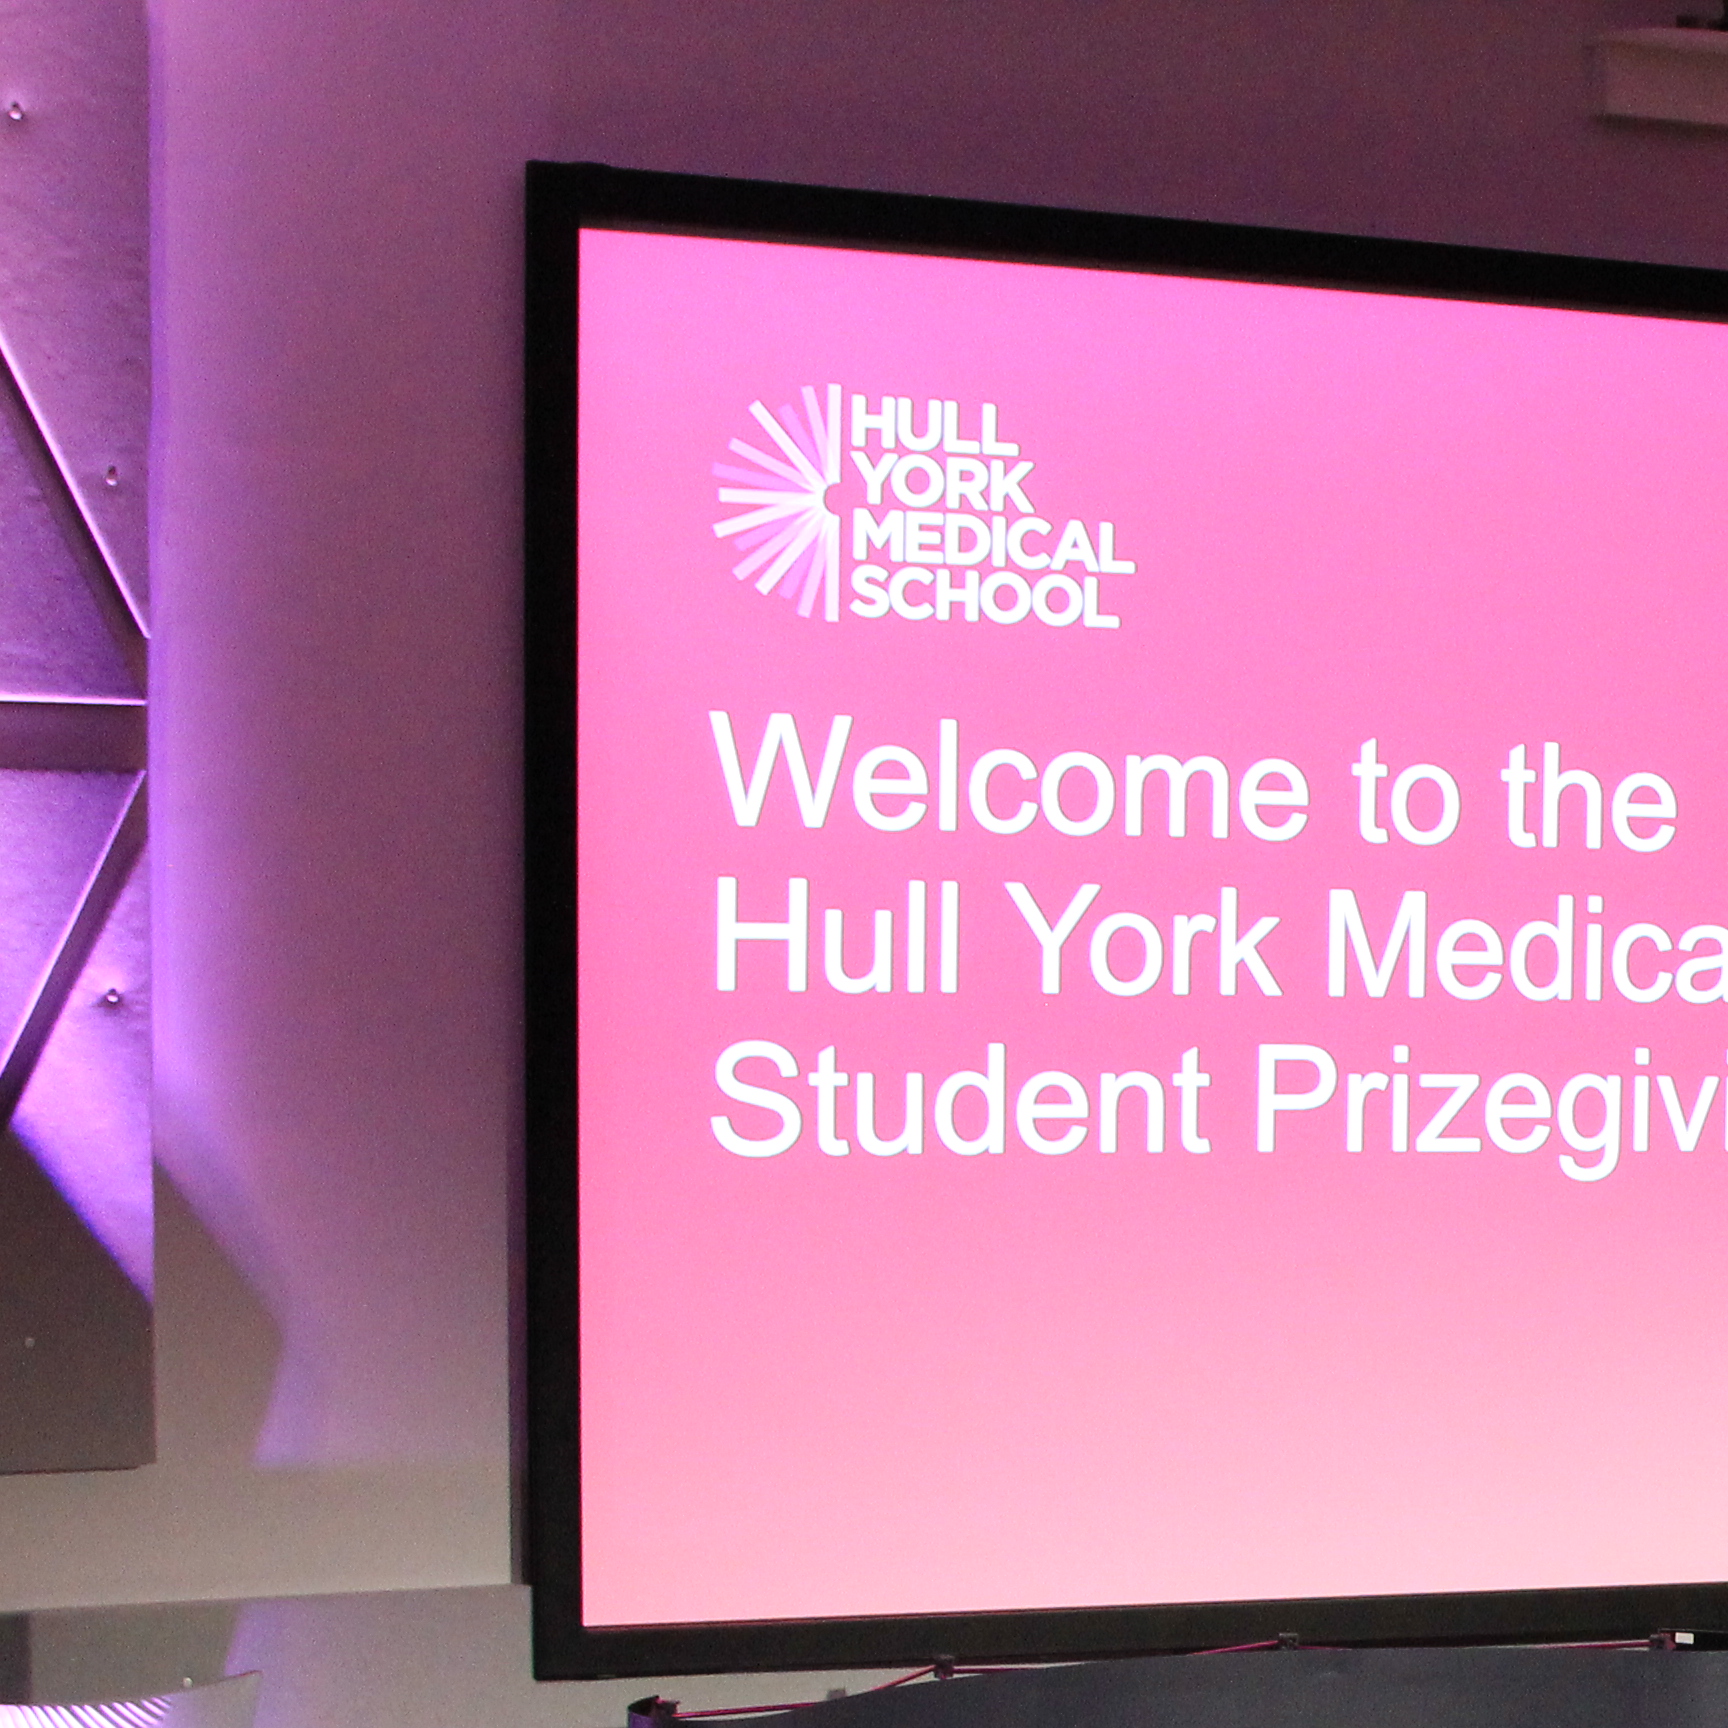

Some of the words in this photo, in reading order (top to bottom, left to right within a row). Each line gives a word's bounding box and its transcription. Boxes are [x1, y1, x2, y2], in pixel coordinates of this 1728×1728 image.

[850, 394, 1020, 457] HULL
[849, 450, 1035, 514] YORK
[852, 507, 1136, 575] MEDICAL
[849, 564, 1120, 629] SCHOOL
[708, 710, 1310, 842] Welcome
[1351, 737, 1461, 847] to
[1501, 741, 1678, 852] the
[715, 876, 959, 994] Hull
[1003, 881, 1284, 997] York
[710, 1039, 1212, 1158] Student
